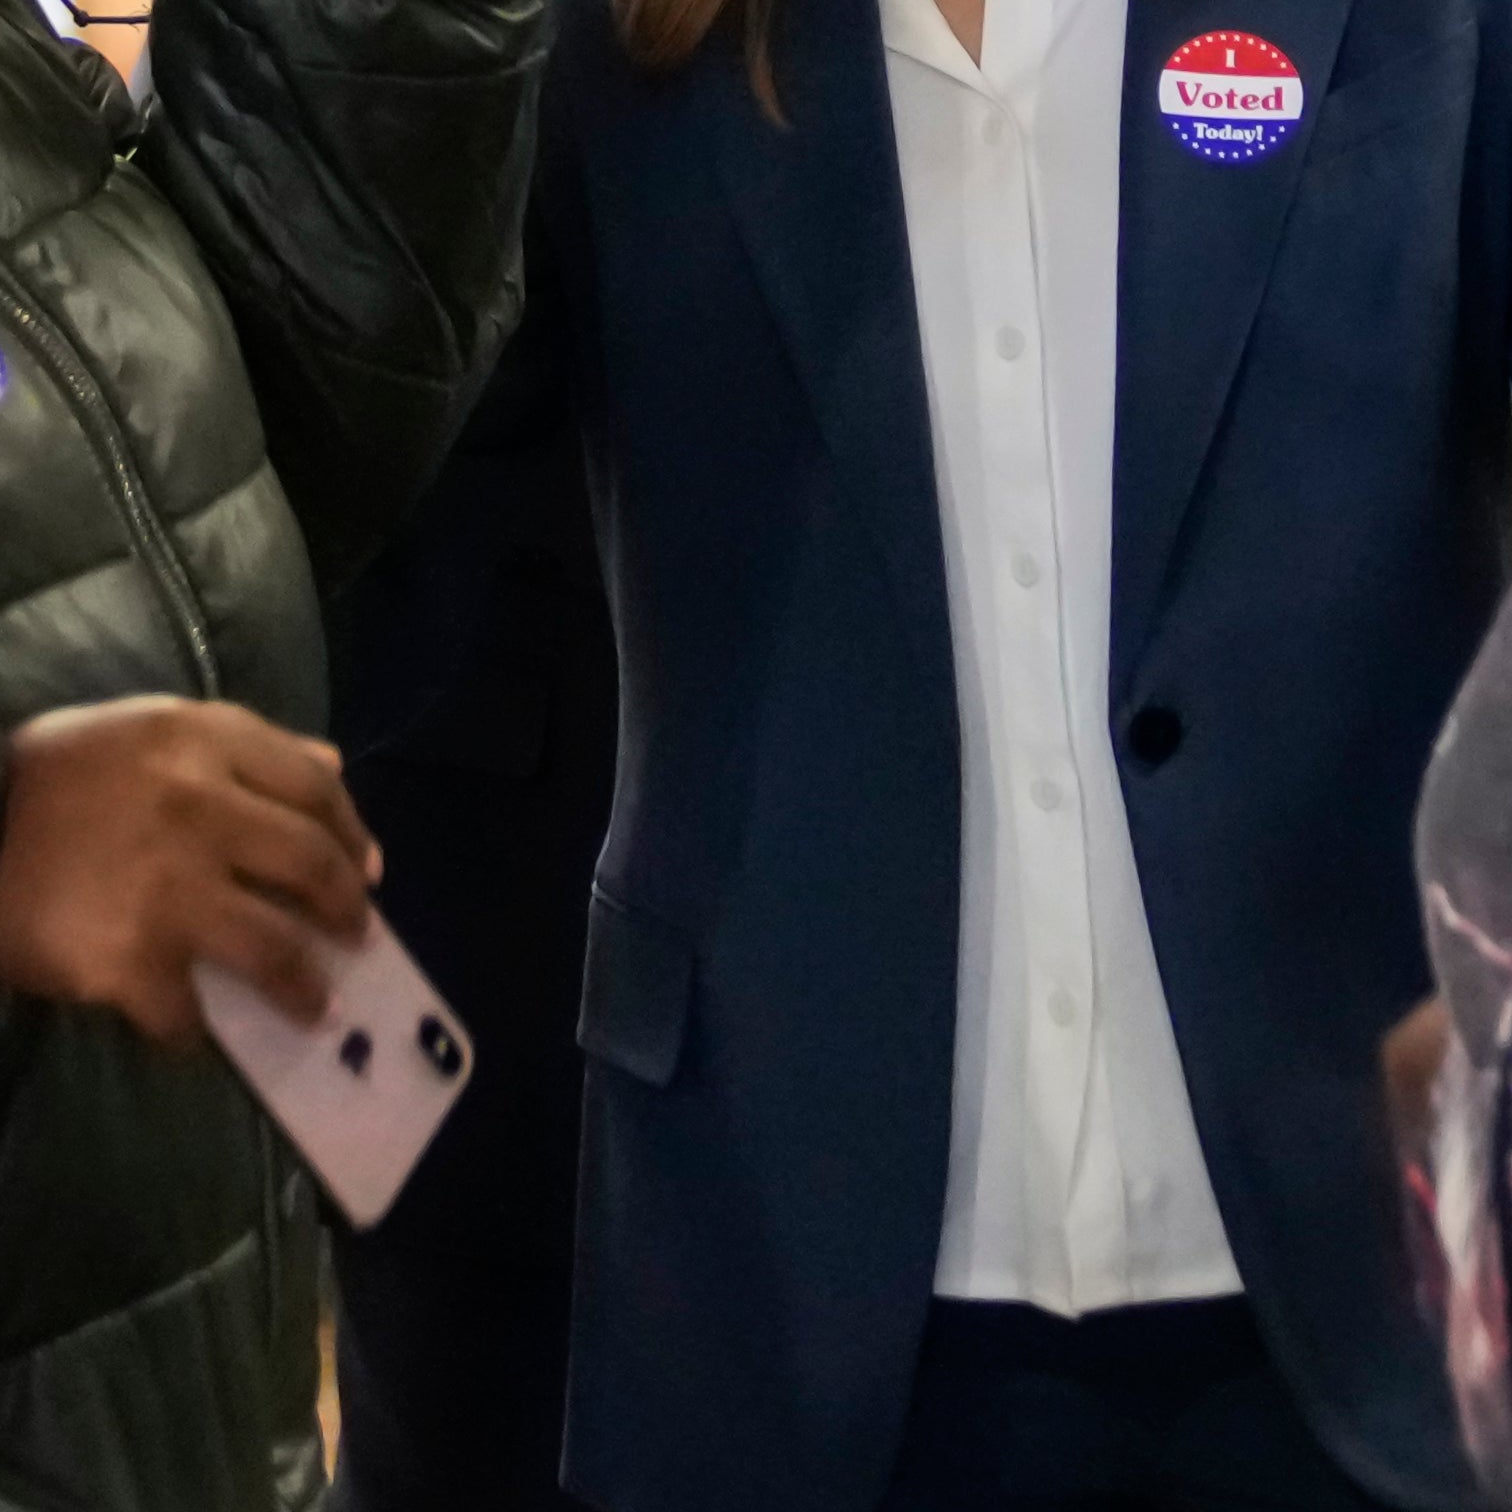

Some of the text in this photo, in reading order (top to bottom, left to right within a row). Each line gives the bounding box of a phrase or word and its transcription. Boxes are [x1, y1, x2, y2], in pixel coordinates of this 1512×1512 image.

[1225, 48, 1236, 68] I
[1176, 81, 1284, 111] Voted
[1193, 122, 1264, 144] Today!
